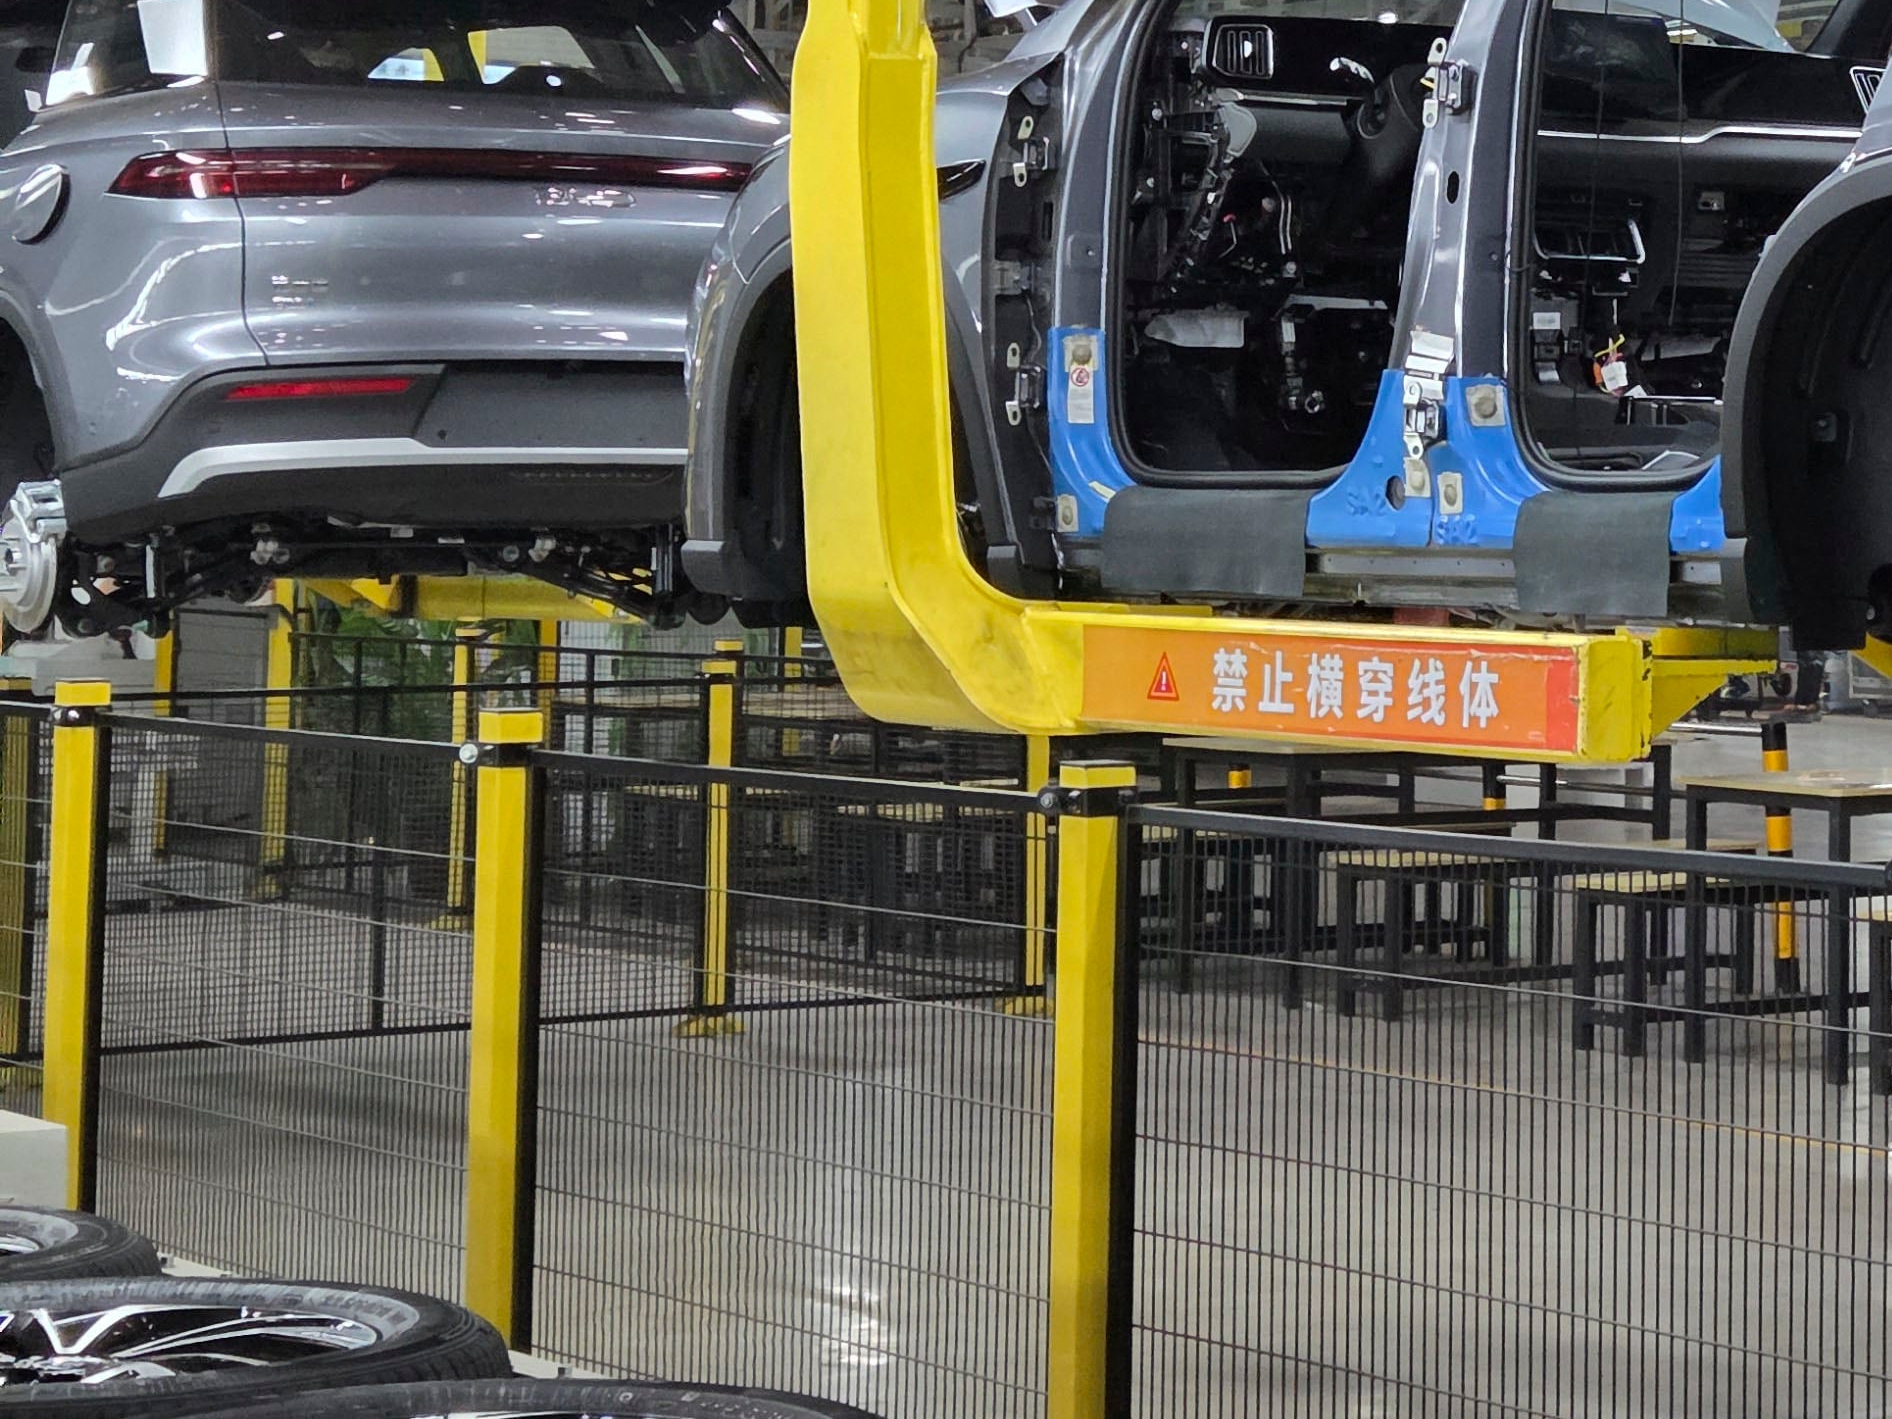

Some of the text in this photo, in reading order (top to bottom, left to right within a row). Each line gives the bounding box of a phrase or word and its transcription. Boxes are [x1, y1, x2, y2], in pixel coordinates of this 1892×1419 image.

[1211, 647, 1500, 730] 禁止横穿线体
